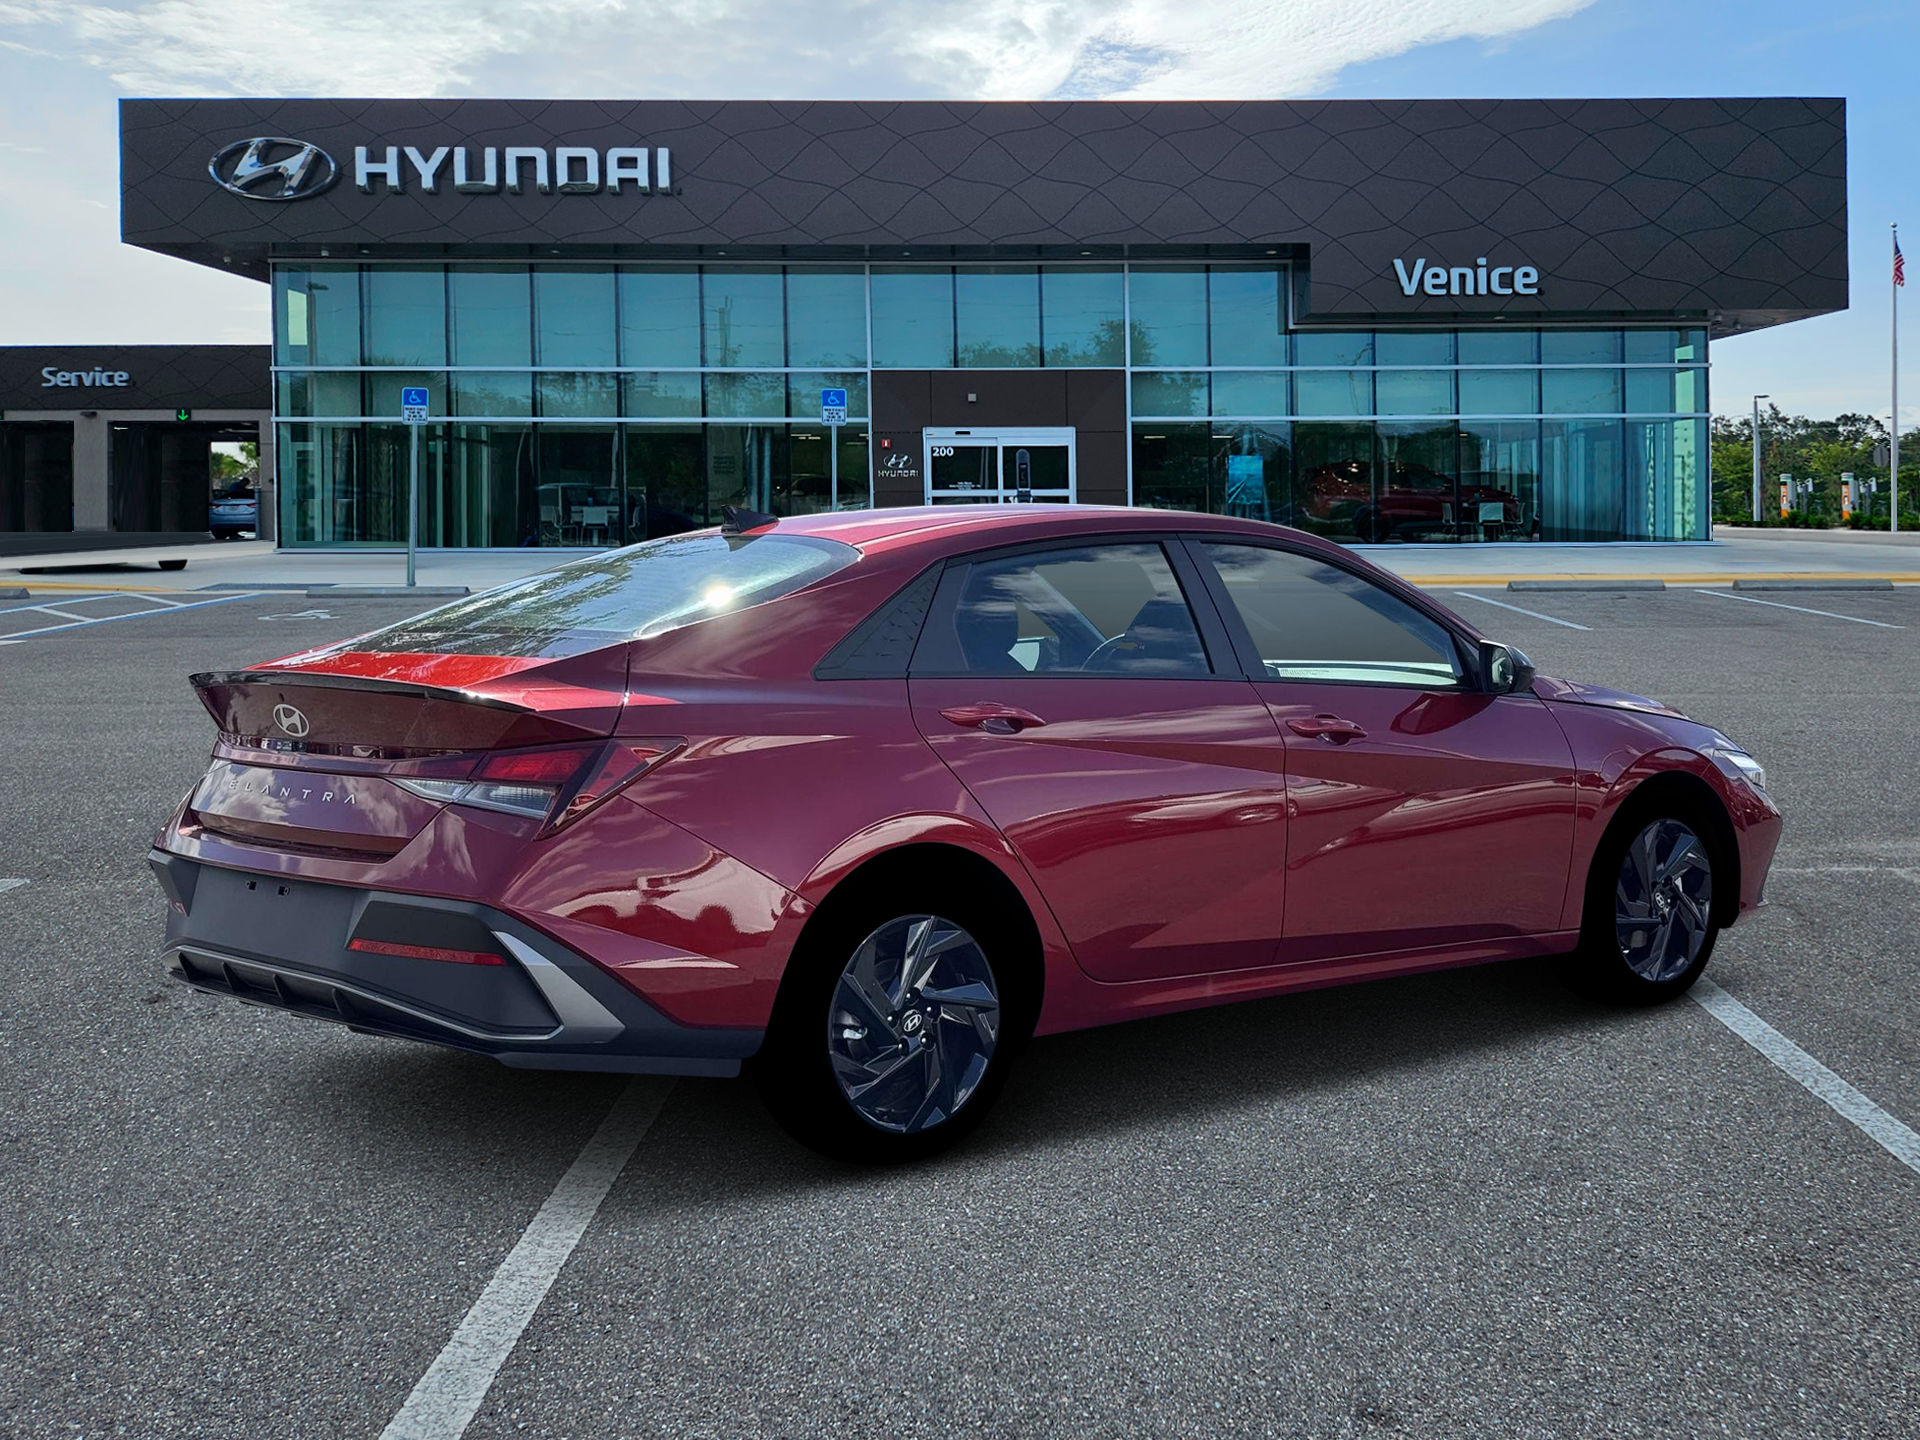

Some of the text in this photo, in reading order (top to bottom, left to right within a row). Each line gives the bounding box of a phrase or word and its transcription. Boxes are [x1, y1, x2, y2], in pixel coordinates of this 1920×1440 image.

[355, 146, 672, 193] HYUNDAI
[1393, 257, 1539, 295] Venice
[41, 366, 130, 387] Service
[932, 447, 954, 457] 200
[229, 780, 356, 805] ELANTRA
